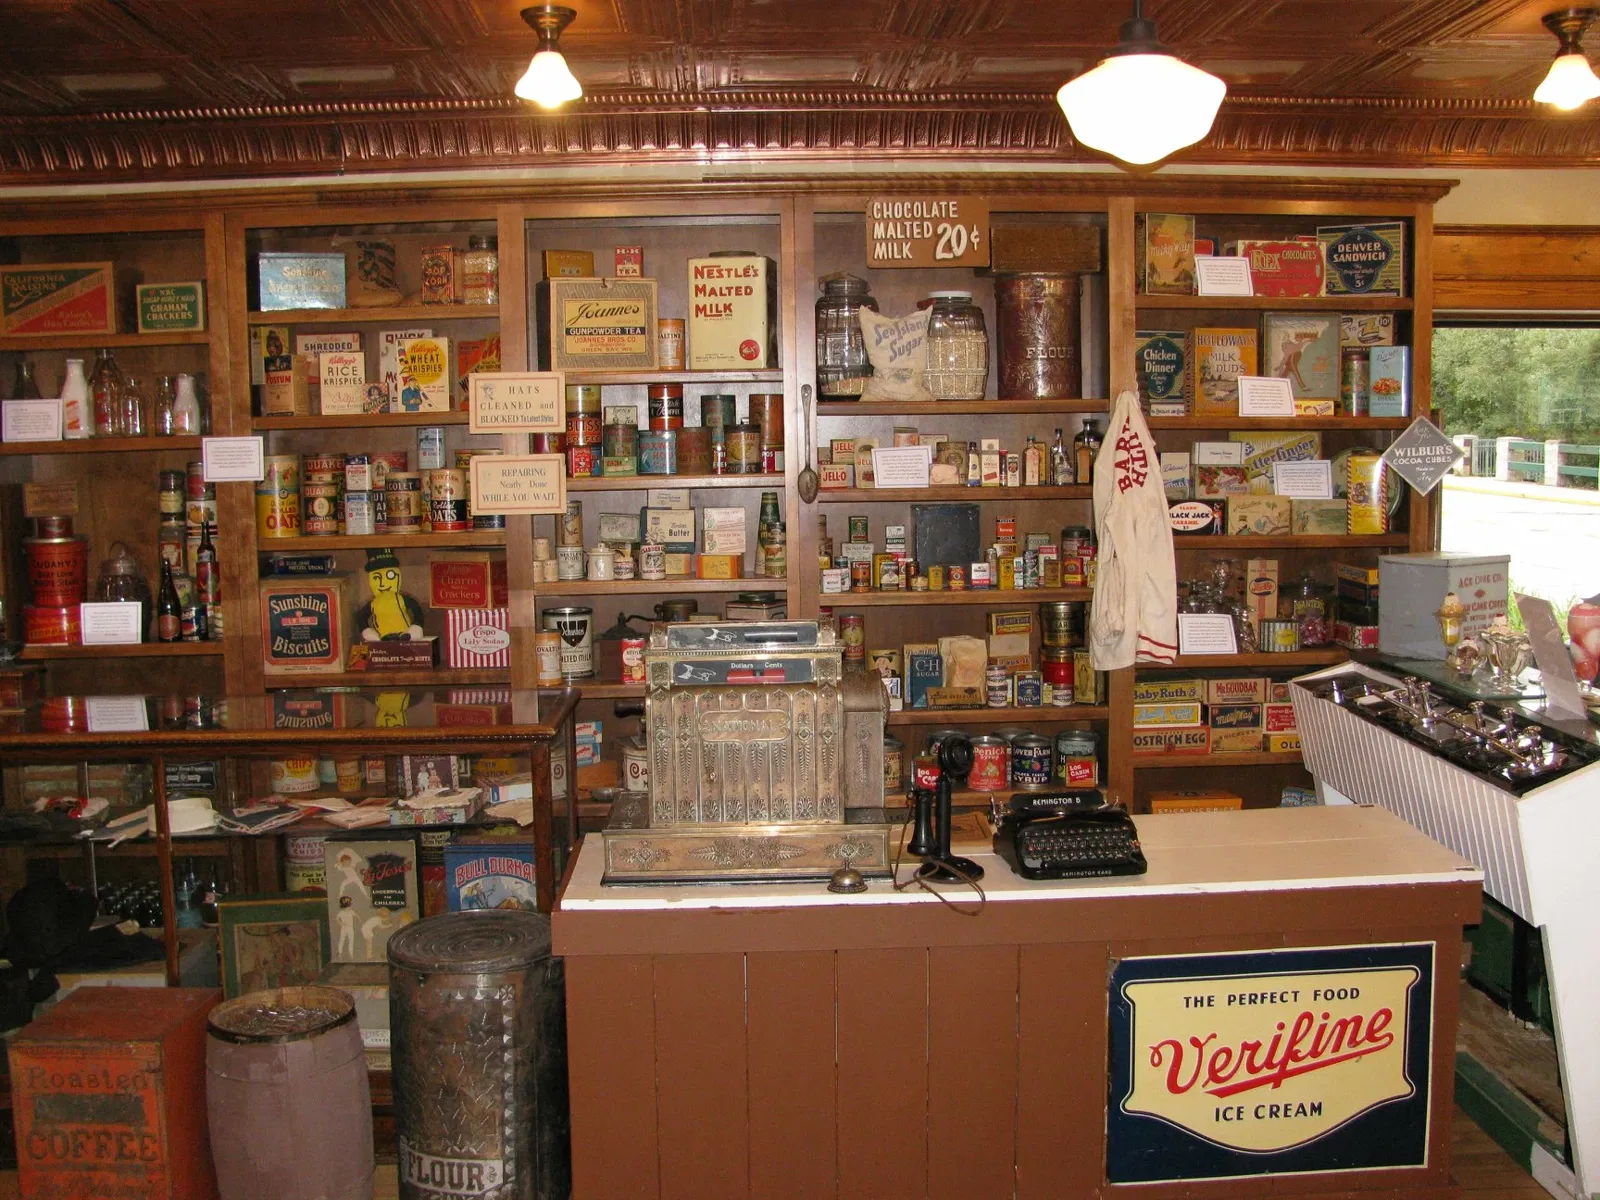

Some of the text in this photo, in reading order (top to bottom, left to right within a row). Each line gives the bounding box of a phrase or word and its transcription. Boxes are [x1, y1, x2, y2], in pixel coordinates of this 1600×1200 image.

[873, 202, 958, 219] CHOCOLATE
[873, 221, 932, 239] MALTED
[874, 242, 912, 259] MILK
[1337, 242, 1381, 252] DENVER
[1333, 251, 1386, 262] SANDWICH
[694, 284, 753, 297] MALTED
[150, 304, 188, 312] GRAHAM
[694, 303, 733, 317] MILK
[147, 312, 193, 320] CRACKERS
[567, 303, 640, 325] Joannes
[569, 328, 621, 336] GUNPOWDER
[304, 342, 353, 351] SHREDDED
[410, 354, 439, 363] WHEAT
[1143, 349, 1177, 360] Chicken
[1209, 353, 1236, 361] MILK
[327, 366, 358, 376] RICE
[408, 365, 442, 373] KRISPIES
[1145, 361, 1175, 373] Dinner
[1216, 364, 1246, 373] DUDS
[323, 378, 363, 386] KRISPIES
[508, 386, 540, 395] HATS
[480, 402, 532, 411] CLEANED
[480, 415, 519, 424] BLOCKED
[1250, 439, 1315, 473] tterfinger
[1394, 444, 1453, 457] WILBUR'S
[1393, 458, 1422, 466] COCOA
[501, 468, 546, 477] REPAIRING
[500, 480, 547, 489] Neatly Done
[482, 492, 556, 502] WHILE YOU WAIT
[266, 514, 300, 530] OATS
[439, 591, 480, 600] Crackers
[271, 595, 327, 614] Sunshine
[472, 627, 496, 638] Crispo
[273, 636, 328, 655] Biscuits
[464, 638, 480, 646] Lily
[765, 661, 783, 669] Cents
[1160, 687, 1187, 698] Ruth
[711, 719, 774, 731] NATIONAL
[1134, 733, 1206, 746] OSTRICH EGG
[973, 746, 1005, 757] Penick
[918, 768, 930, 778] LOG
[1033, 798, 1072, 806] REMINGTON
[455, 862, 486, 886] BULL
[1183, 987, 1360, 1009] THE PERFECT FOOD
[1149, 1007, 1394, 1098] Verifine
[1215, 1101, 1323, 1121] ICE CREAM
[27, 1128, 158, 1162] COFFEE
[409, 1155, 485, 1192] FLOUR
